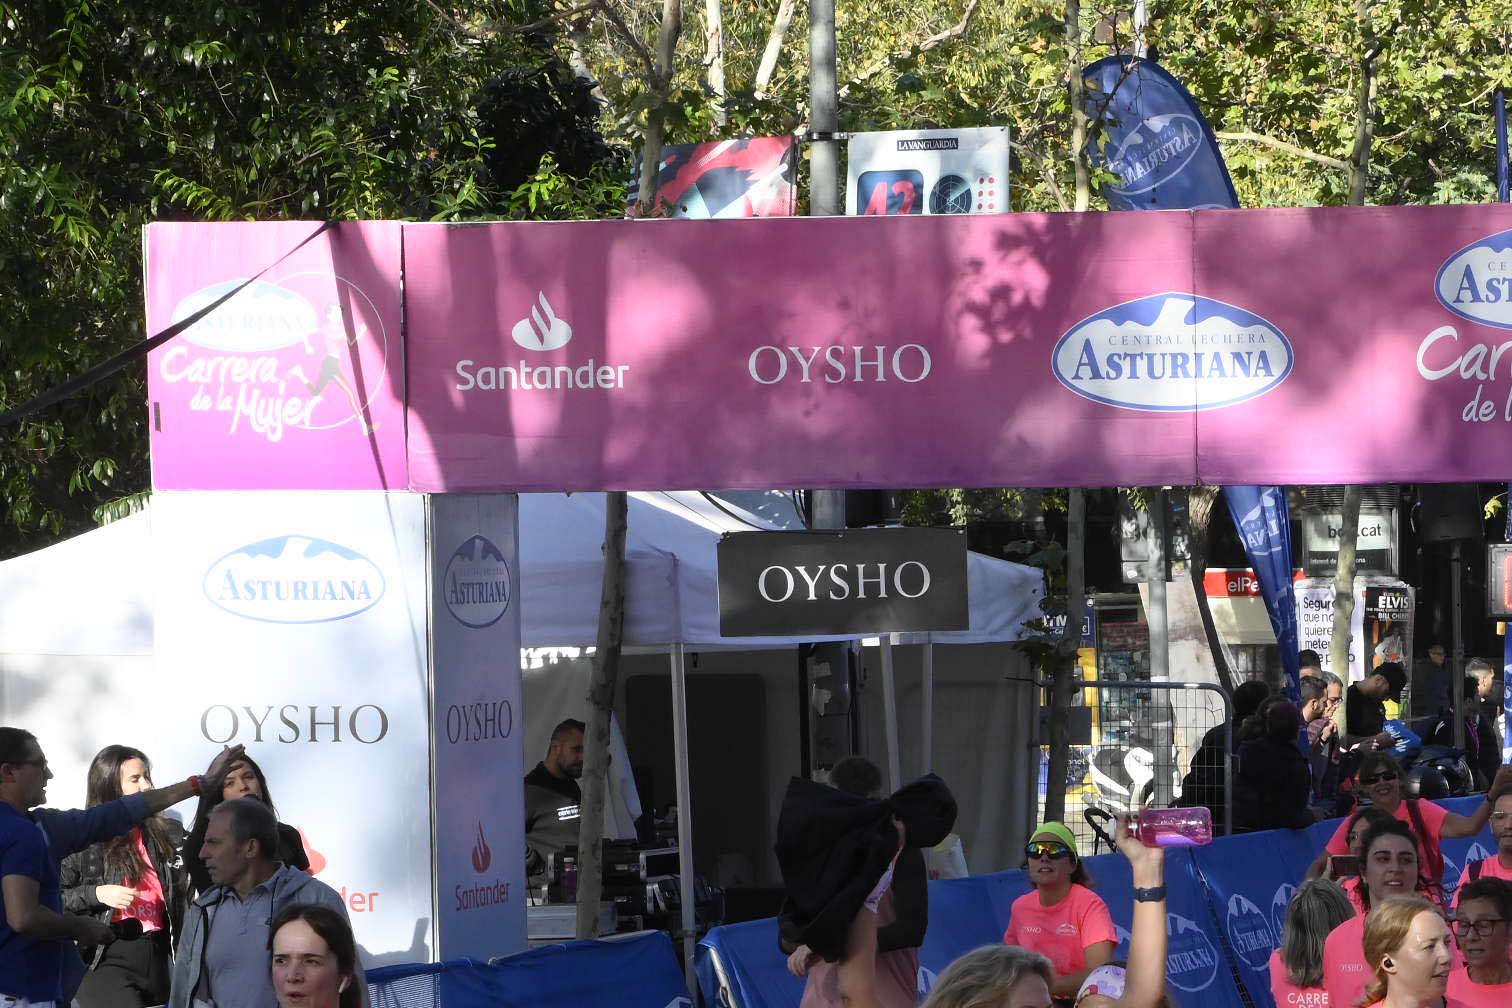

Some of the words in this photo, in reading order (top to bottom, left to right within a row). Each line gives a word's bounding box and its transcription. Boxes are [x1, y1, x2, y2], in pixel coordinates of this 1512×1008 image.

[1108, 334, 1184, 345] CENTRAL
[1189, 332, 1267, 344] LECHERA
[160, 346, 284, 384] Carrera
[455, 359, 630, 391] Santander
[748, 344, 932, 385] OYSHO
[1071, 337, 1275, 381] ASTURIANA
[190, 385, 211, 411] de
[216, 383, 232, 411] la
[229, 382, 323, 441] Mujer
[1462, 384, 1496, 423] de
[219, 570, 372, 601] ASTURIANA
[449, 576, 508, 606] ASTURIANA
[758, 561, 931, 603] OYSHO
[1378, 595, 1409, 609] ELVIS
[200, 704, 389, 744] OYSHO
[447, 699, 512, 745] OYSHO
[455, 881, 510, 912] Santander
[1287, 992, 1329, 1005] CARRE
